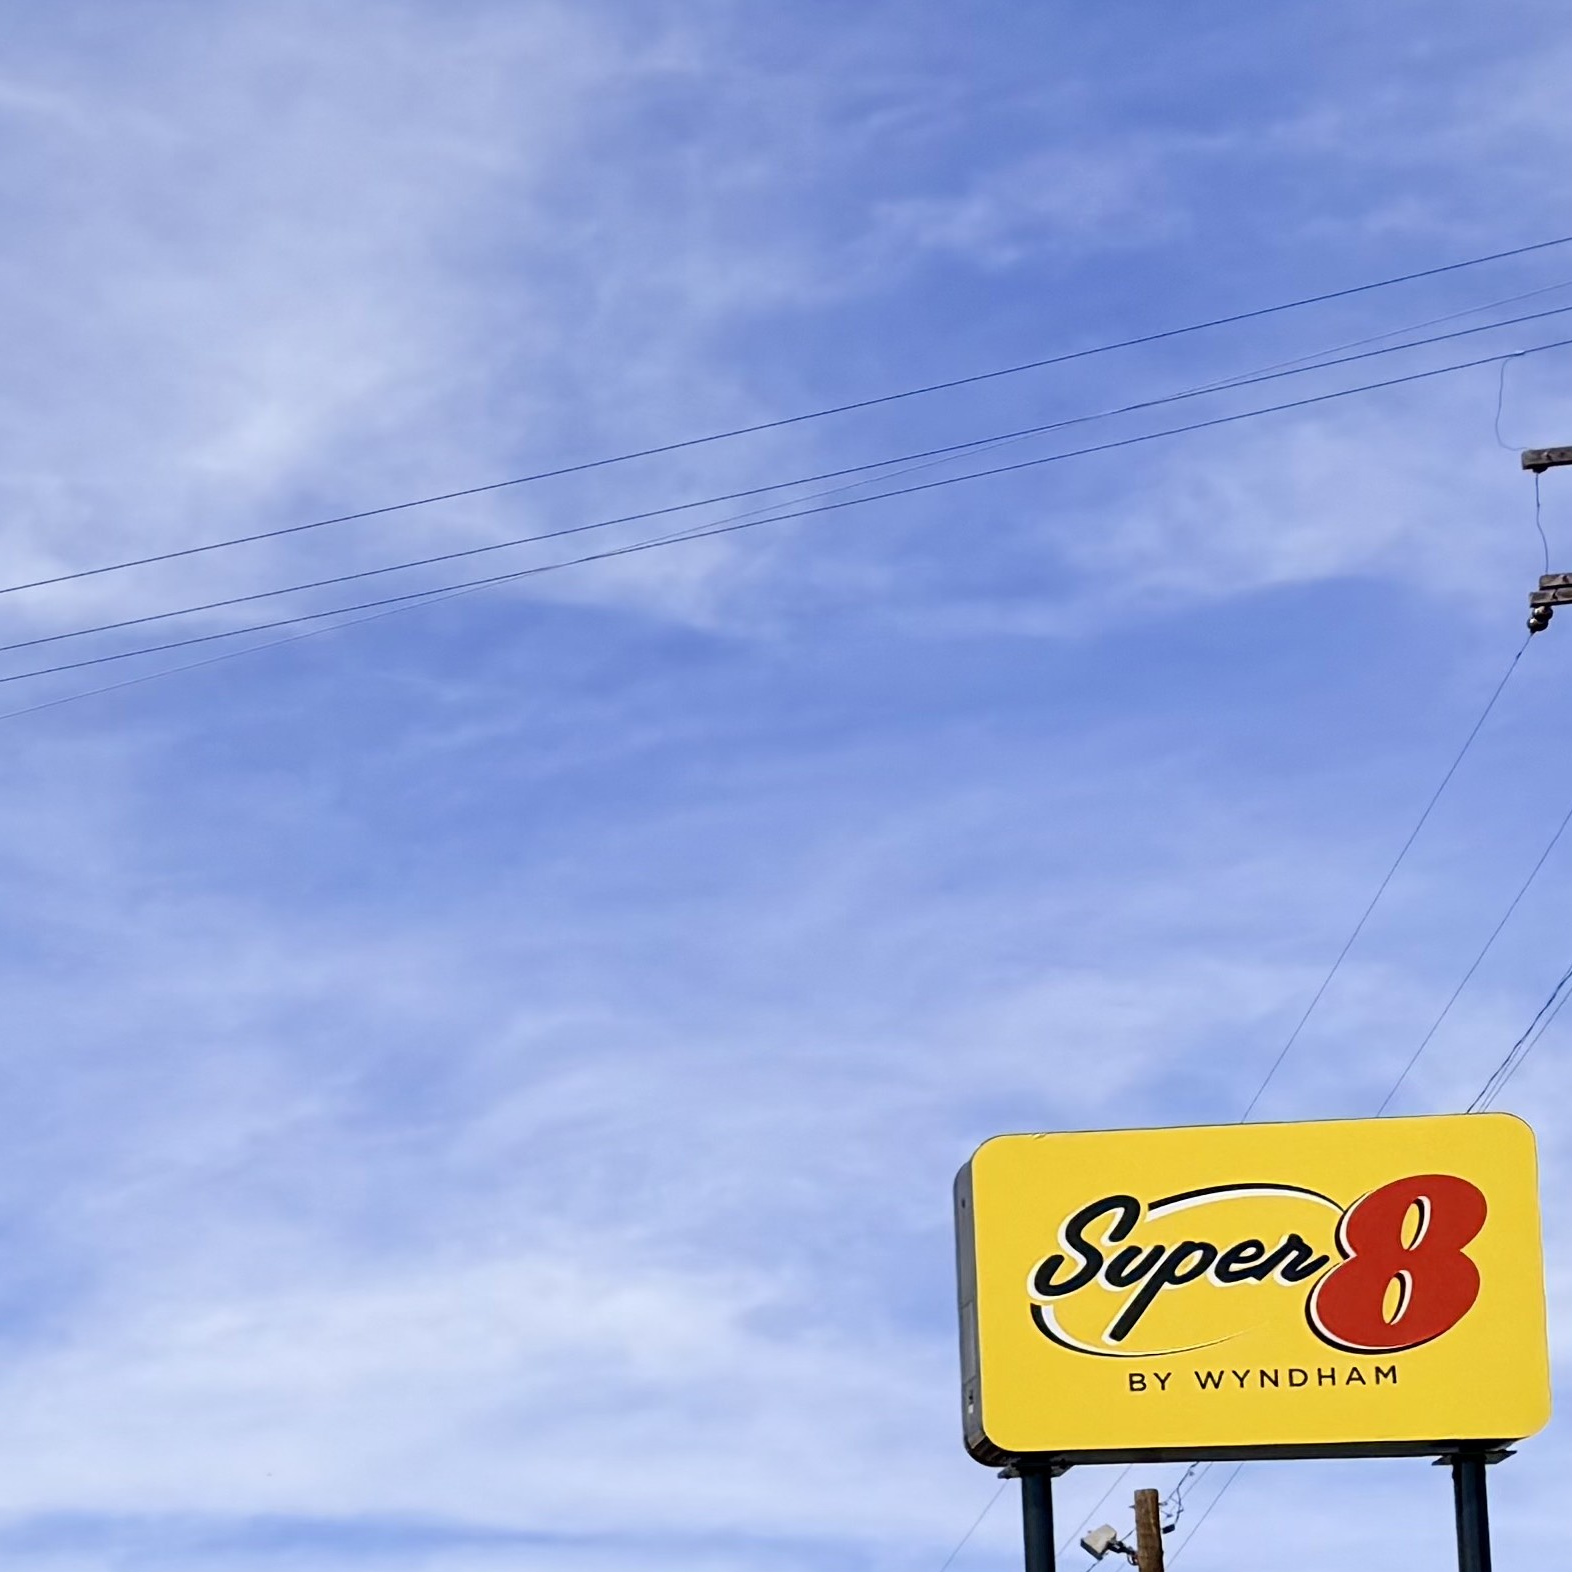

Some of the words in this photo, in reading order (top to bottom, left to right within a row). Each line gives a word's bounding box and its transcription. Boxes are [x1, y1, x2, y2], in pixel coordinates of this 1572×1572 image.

[1031, 1194, 1331, 1343] Super
[1306, 1173, 1488, 1355] 8
[1128, 1371, 1172, 1393] BY
[1195, 1364, 1399, 1391] WYNDHAM
